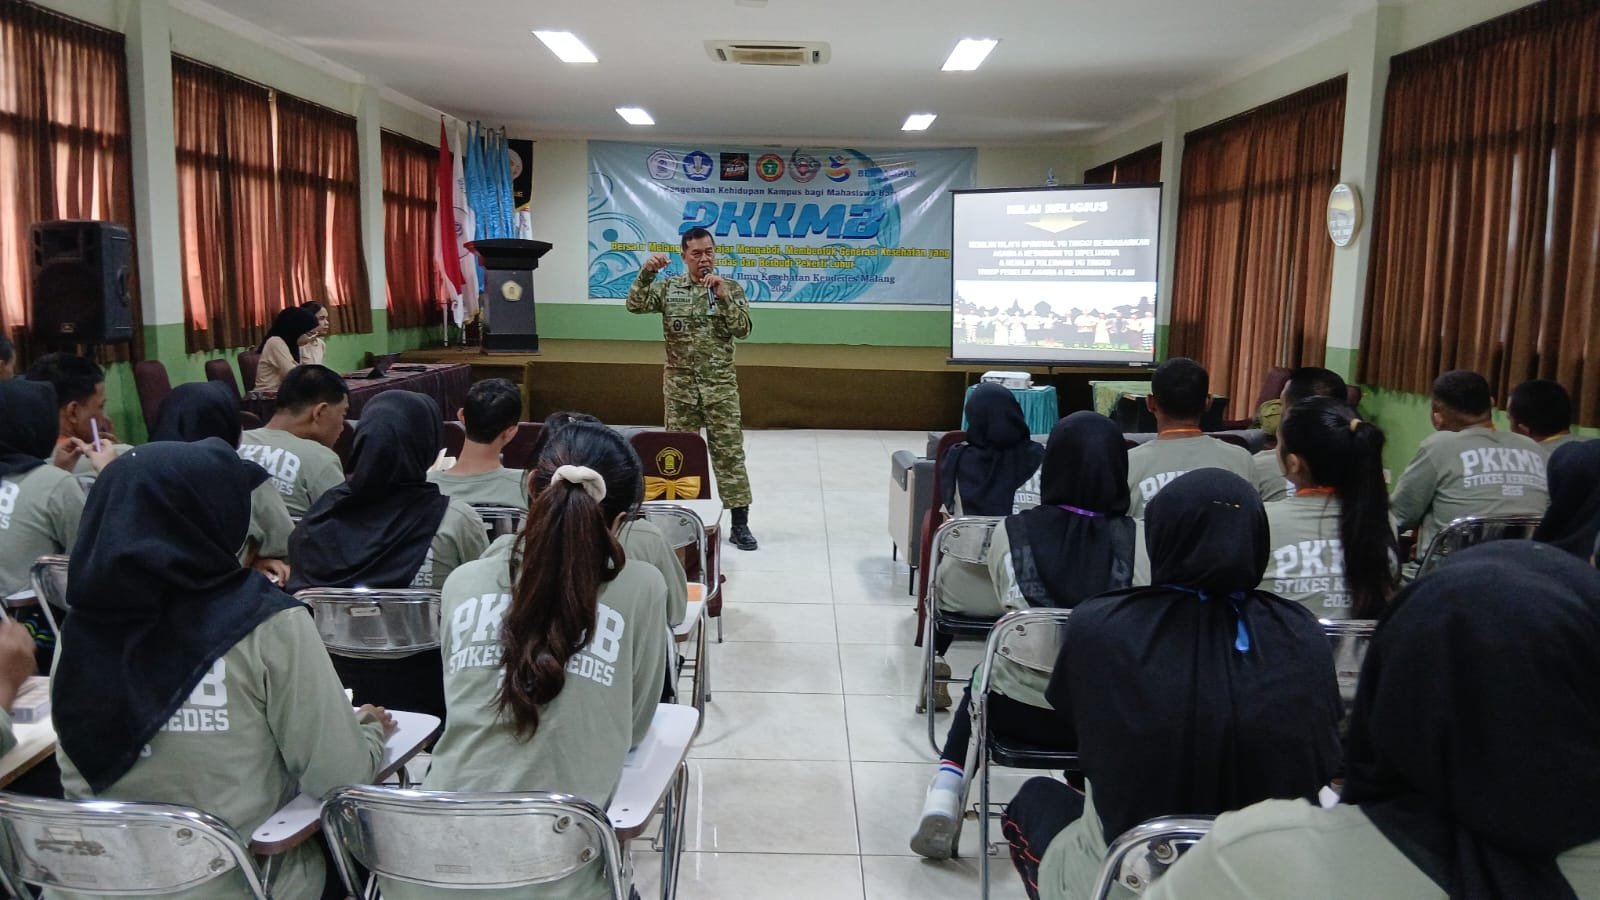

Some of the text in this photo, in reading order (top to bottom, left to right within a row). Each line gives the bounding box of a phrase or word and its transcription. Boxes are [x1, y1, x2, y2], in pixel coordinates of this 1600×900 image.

[718, 186, 765, 196] Kehidupan
[767, 187, 802, 196] Kampus
[804, 188, 824, 198] bagi
[826, 188, 877, 197] Mahasiswa
[1044, 201, 1108, 214] ELIGIUS
[678, 200, 886, 240] PKKMB
[648, 241, 682, 253] Melang
[784, 245, 837, 256] Membentuk
[839, 245, 877, 257] Generasi
[880, 247, 926, 257] Kesehatan
[928, 248, 949, 259] yang
[739, 257, 757, 267] dan
[860, 274, 896, 285] Malang
[1463, 473, 1505, 488] STIKES
[1274, 577, 1330, 593] STIKES
[1323, 593, 1354, 608] 202
[452, 593, 625, 663] PKB
